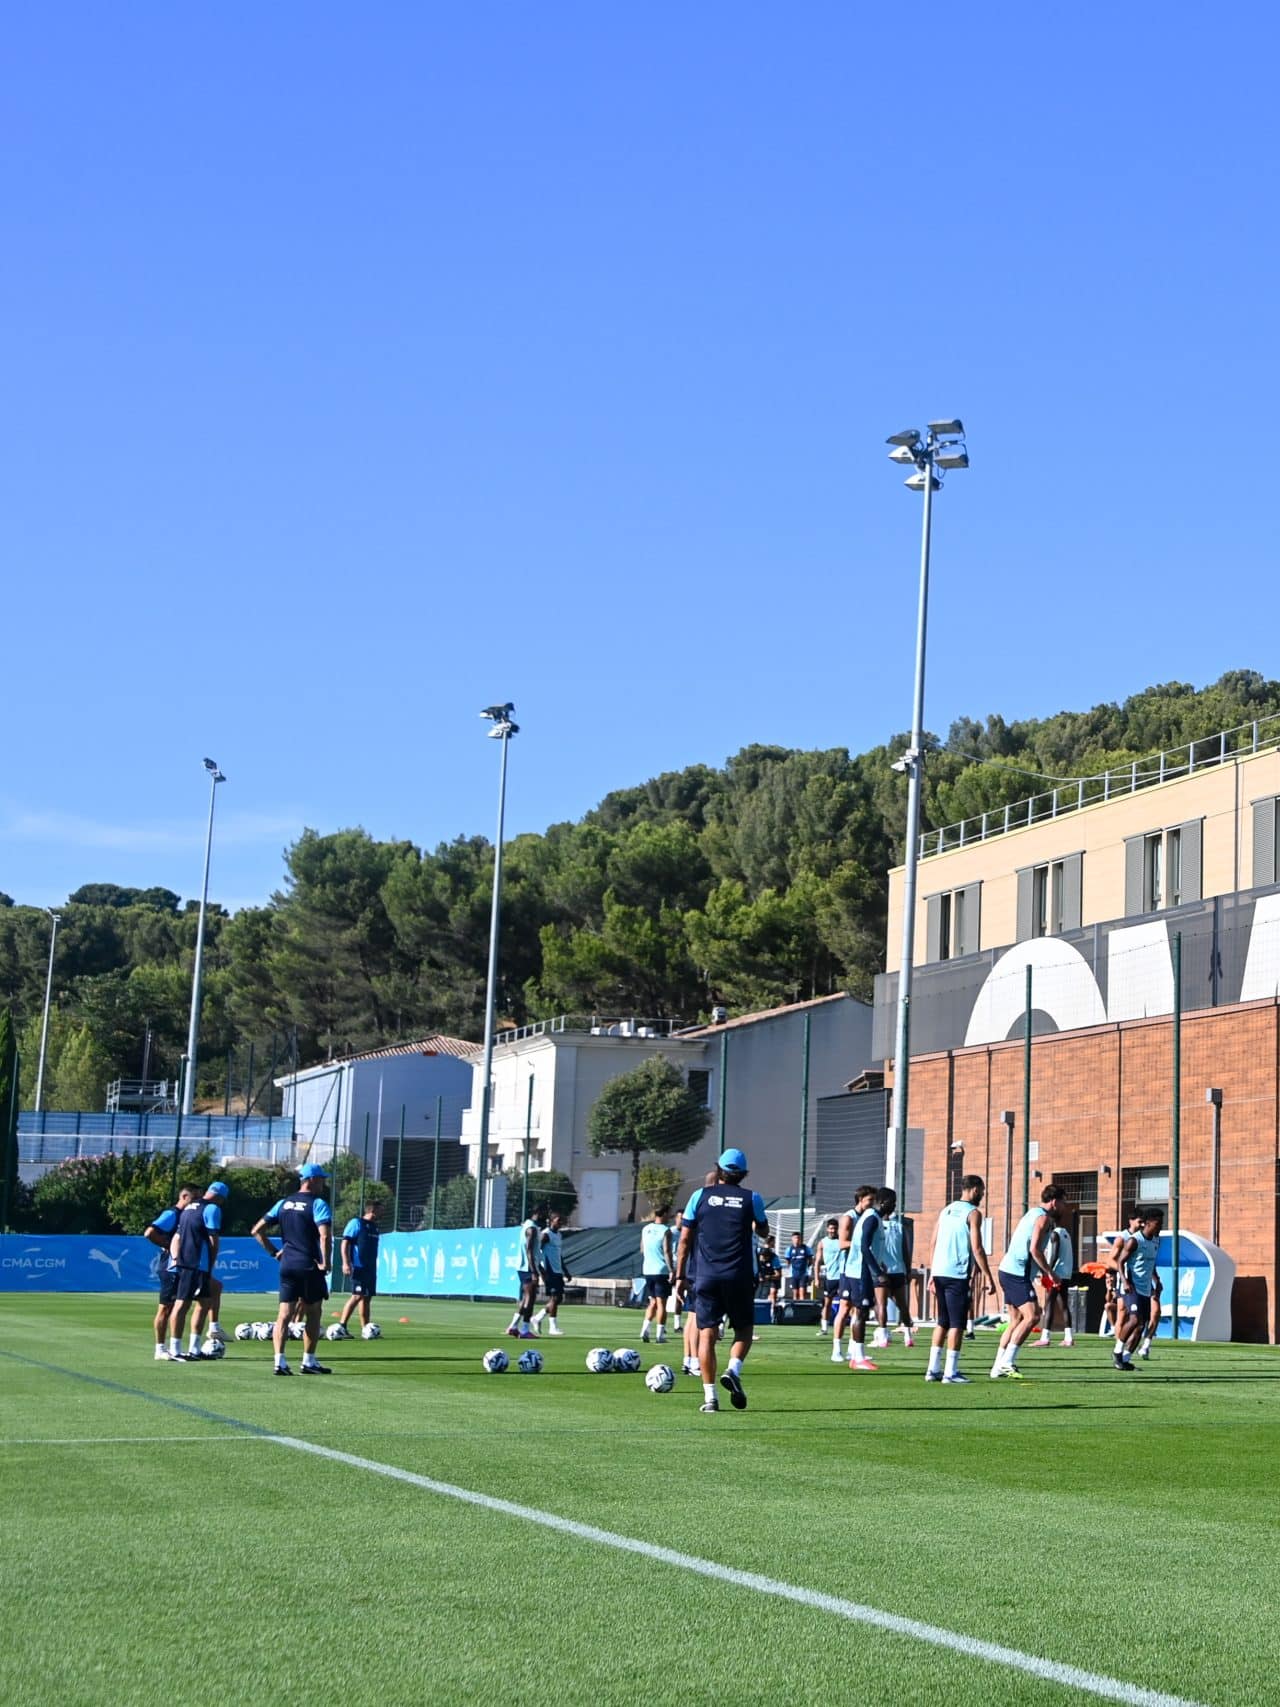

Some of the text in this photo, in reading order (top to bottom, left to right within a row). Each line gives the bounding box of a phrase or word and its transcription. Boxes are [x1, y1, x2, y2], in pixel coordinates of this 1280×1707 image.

[2, 1257, 66, 1269] CMA CGM
[230, 1259, 260, 1270] CGM
